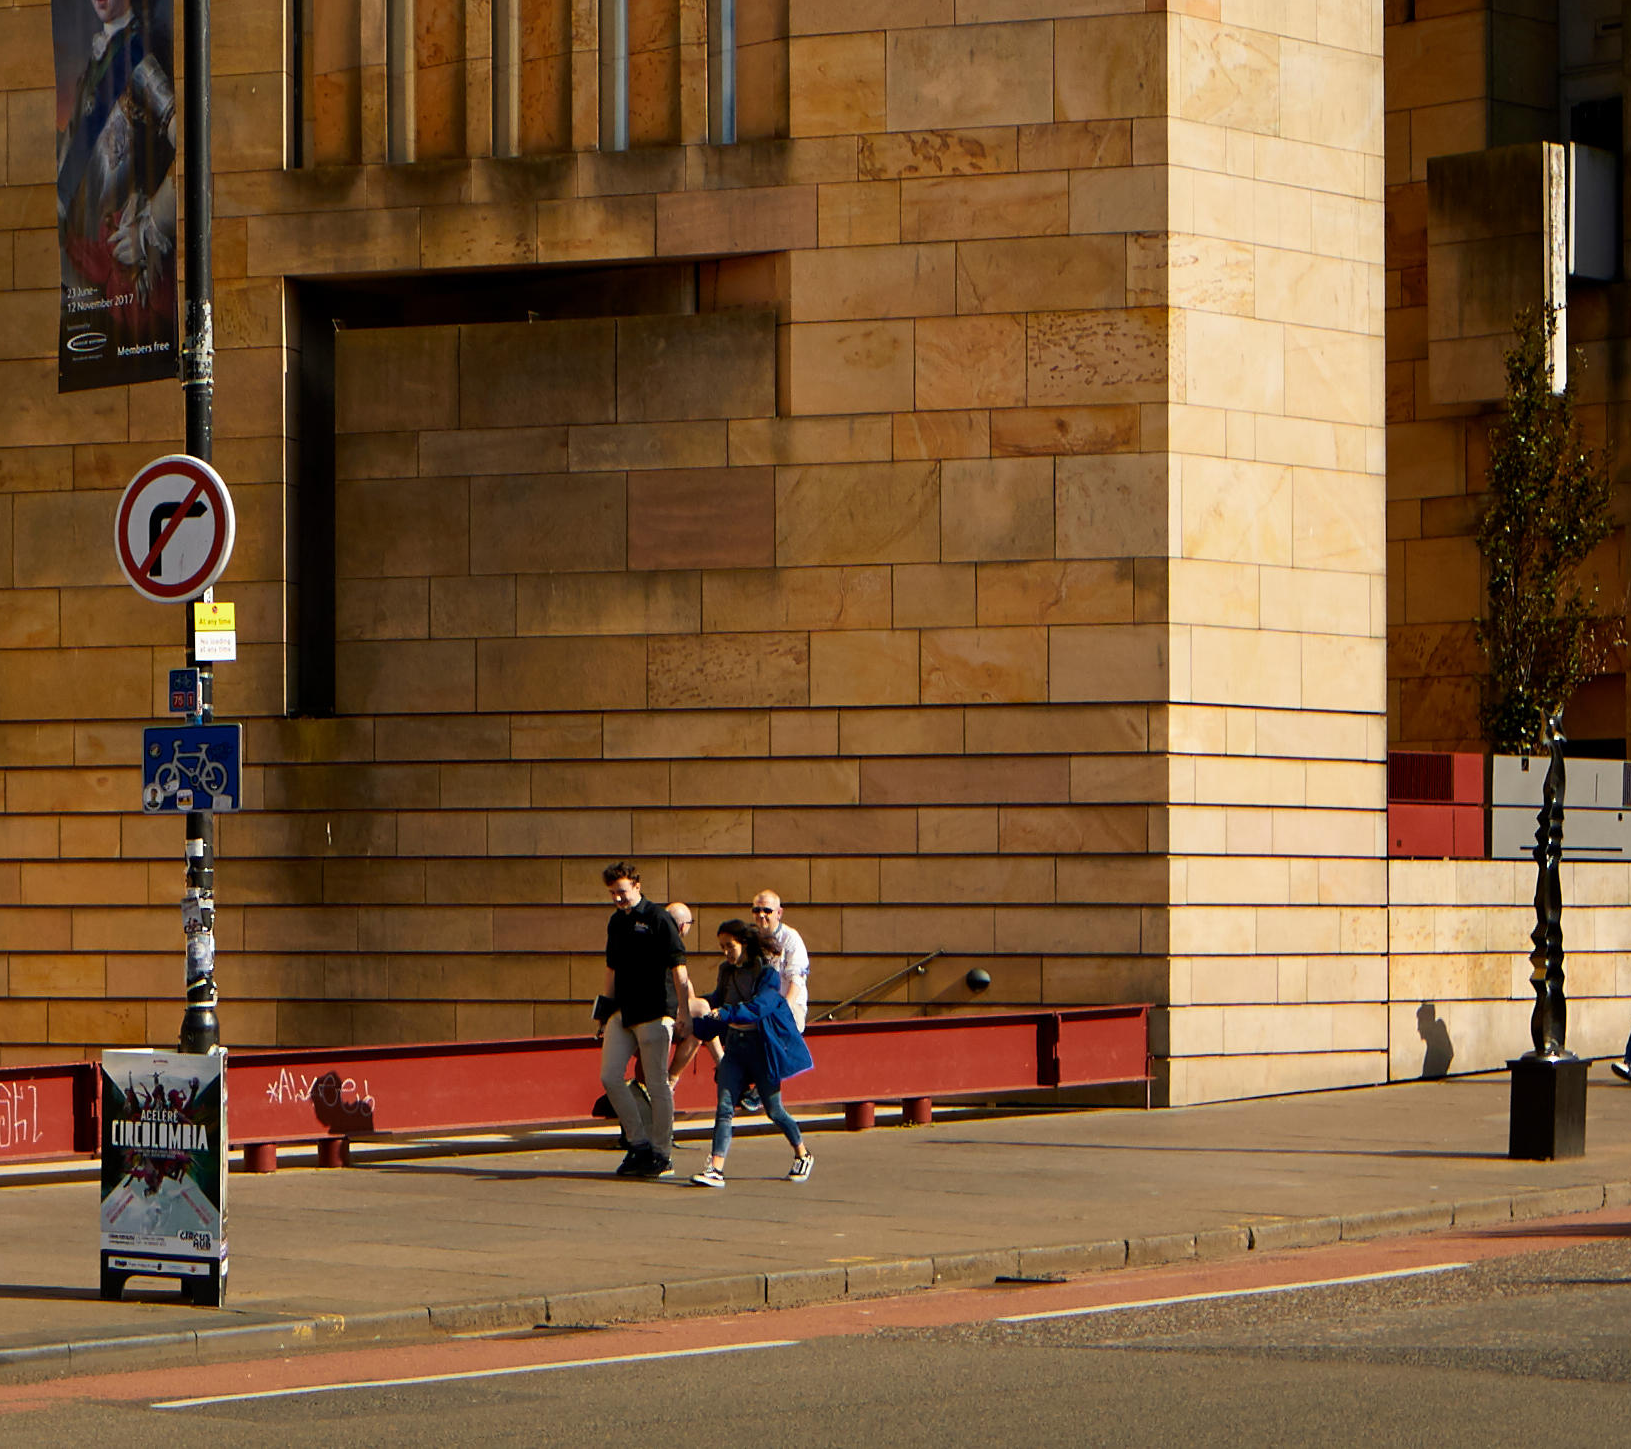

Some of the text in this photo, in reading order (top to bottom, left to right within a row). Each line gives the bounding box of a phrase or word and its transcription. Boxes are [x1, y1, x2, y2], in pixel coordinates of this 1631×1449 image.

[67, 294, 134, 313] 12 November 2017
[117, 340, 170, 357] Members free
[111, 1119, 209, 1151] CIRCOLOMBIA
